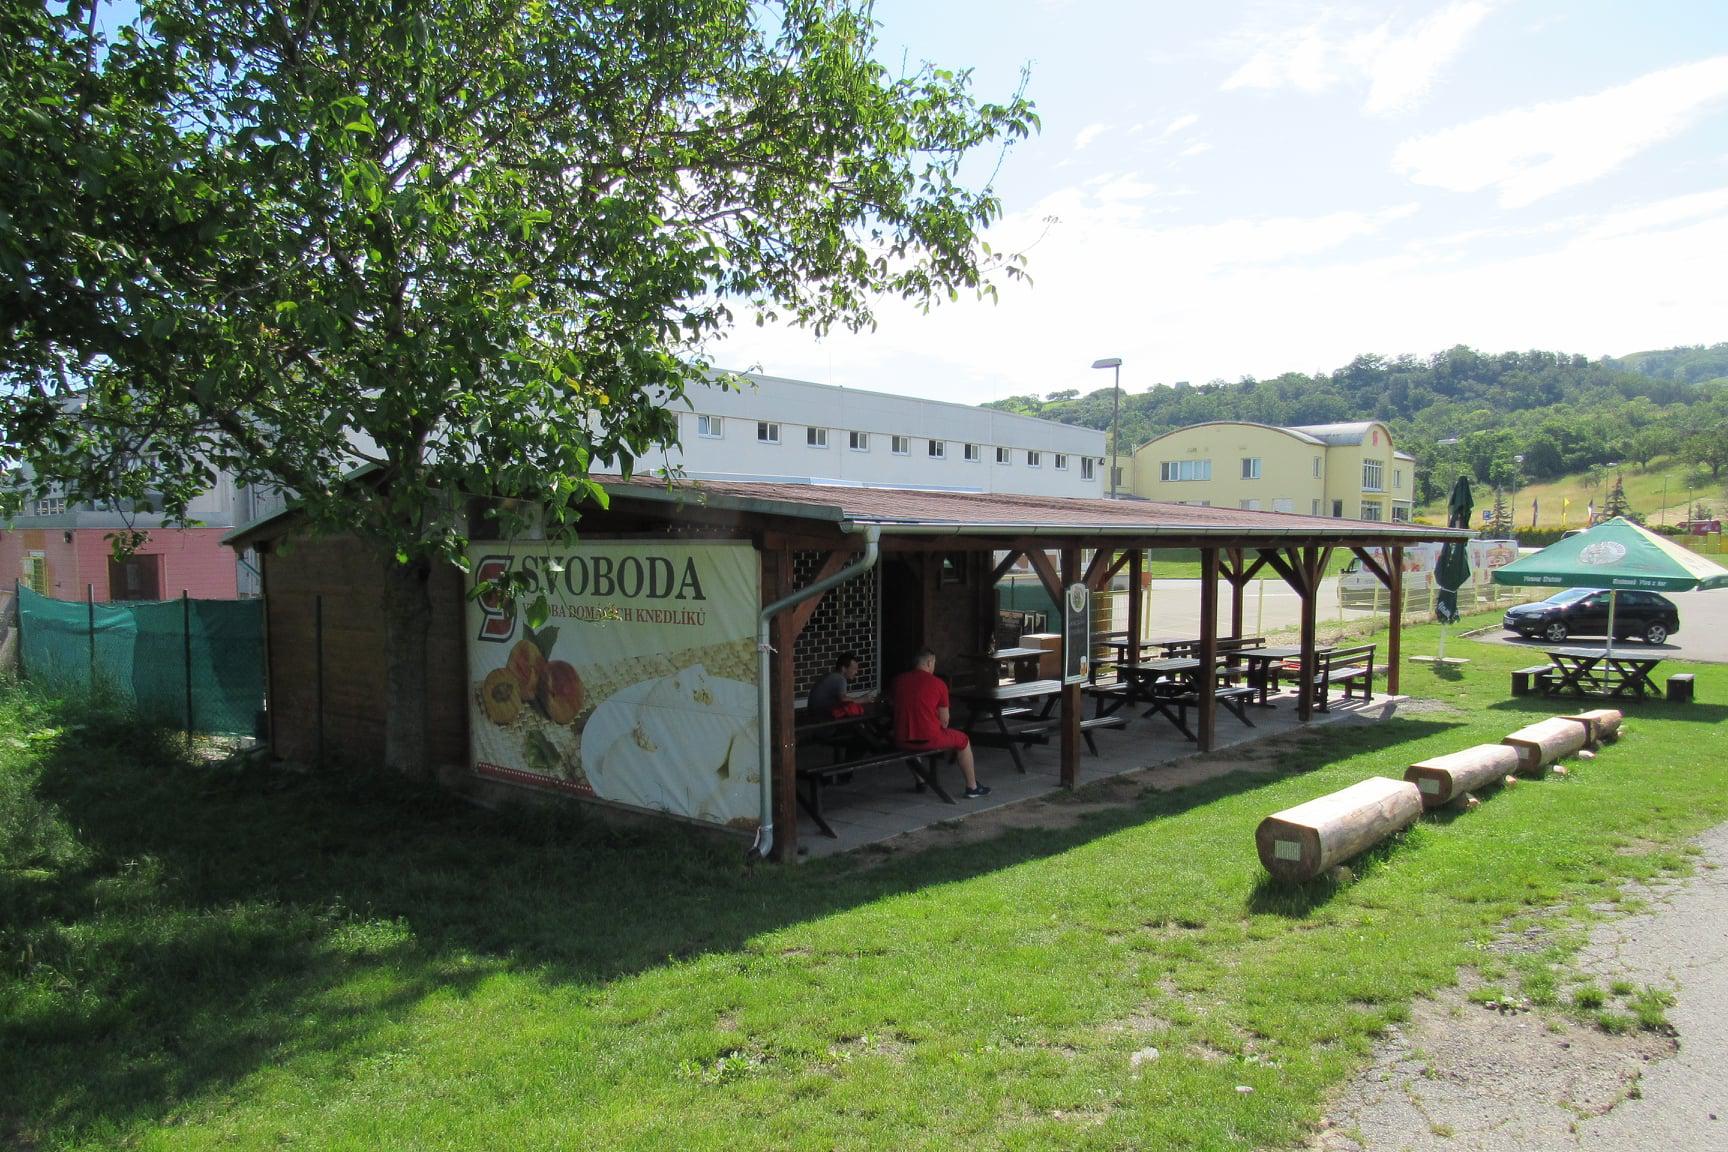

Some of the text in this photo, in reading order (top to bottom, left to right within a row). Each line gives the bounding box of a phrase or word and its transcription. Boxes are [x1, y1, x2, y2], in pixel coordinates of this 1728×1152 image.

[521, 555, 707, 601] SVOBODA
[522, 601, 566, 618] VBA
[636, 606, 706, 627] KNEDLÍKŮ
